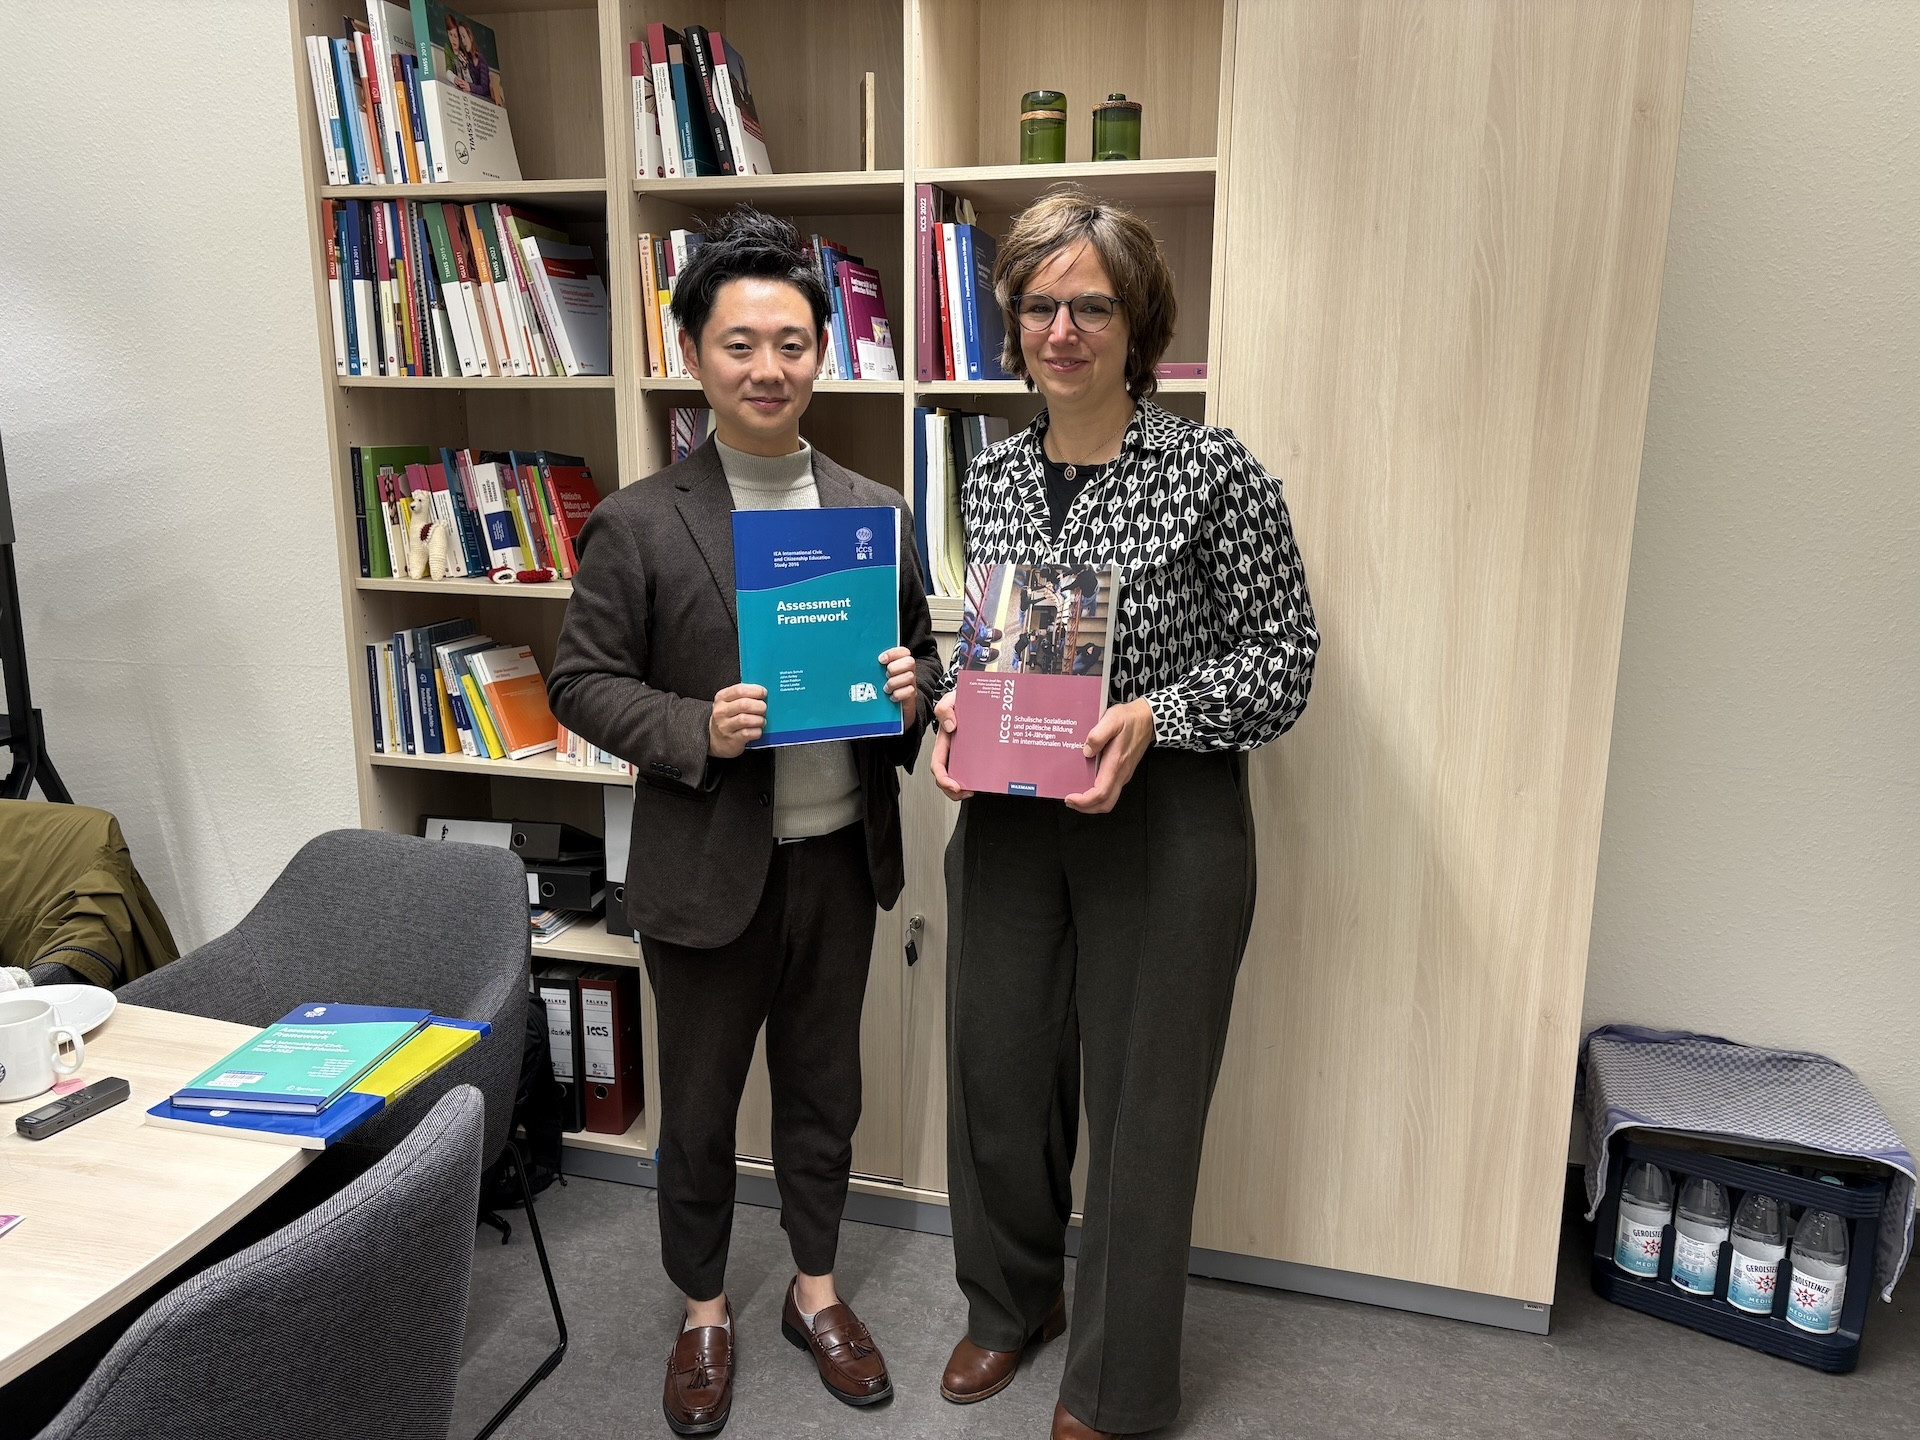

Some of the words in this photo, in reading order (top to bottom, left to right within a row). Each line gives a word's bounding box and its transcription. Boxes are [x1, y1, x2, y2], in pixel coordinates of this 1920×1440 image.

[703, 77, 711, 96] SCIENCE
[462, 96, 470, 120] 2015
[466, 122, 476, 151] TIMSS
[375, 212, 384, 244] Compasito
[493, 261, 501, 278] TIMSS
[777, 597, 851, 611] Assessment
[777, 610, 848, 625] Framework
[850, 683, 877, 702] IEA
[1002, 680, 1014, 711] 2022
[999, 714, 1012, 743] ICCS
[1043, 718, 1077, 726] Sozialisation
[1020, 739, 1061, 747] internationalen
[1062, 741, 1086, 750] Vergleic
[1024, 731, 1056, 739] 14-Jährigen
[1791, 1274, 1830, 1294] EROLSTEINER
[1789, 1307, 1819, 1322] MEDIUM
